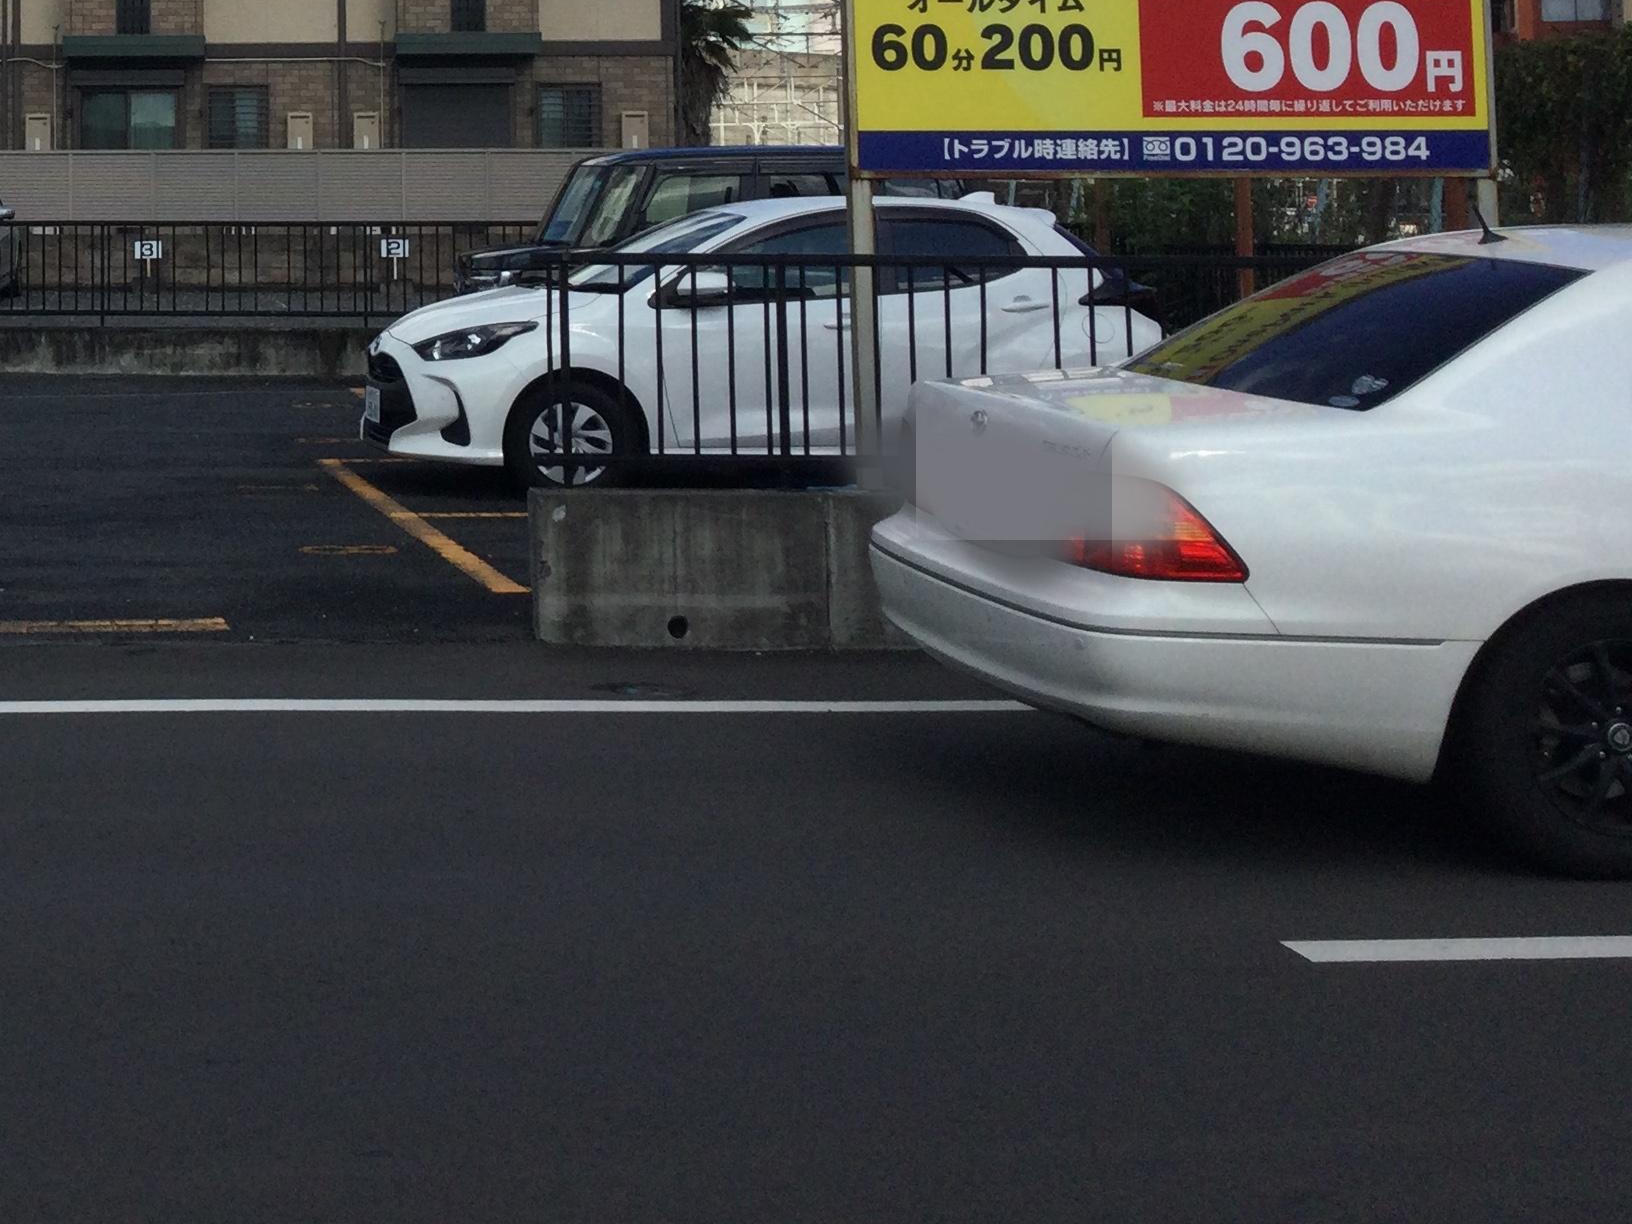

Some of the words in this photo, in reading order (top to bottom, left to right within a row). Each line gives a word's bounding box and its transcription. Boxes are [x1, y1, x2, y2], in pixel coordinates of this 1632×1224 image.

[1174, 136, 1431, 161] 0120-963-984
[142, 242, 154, 257] 3
[388, 240, 401, 255] 2
